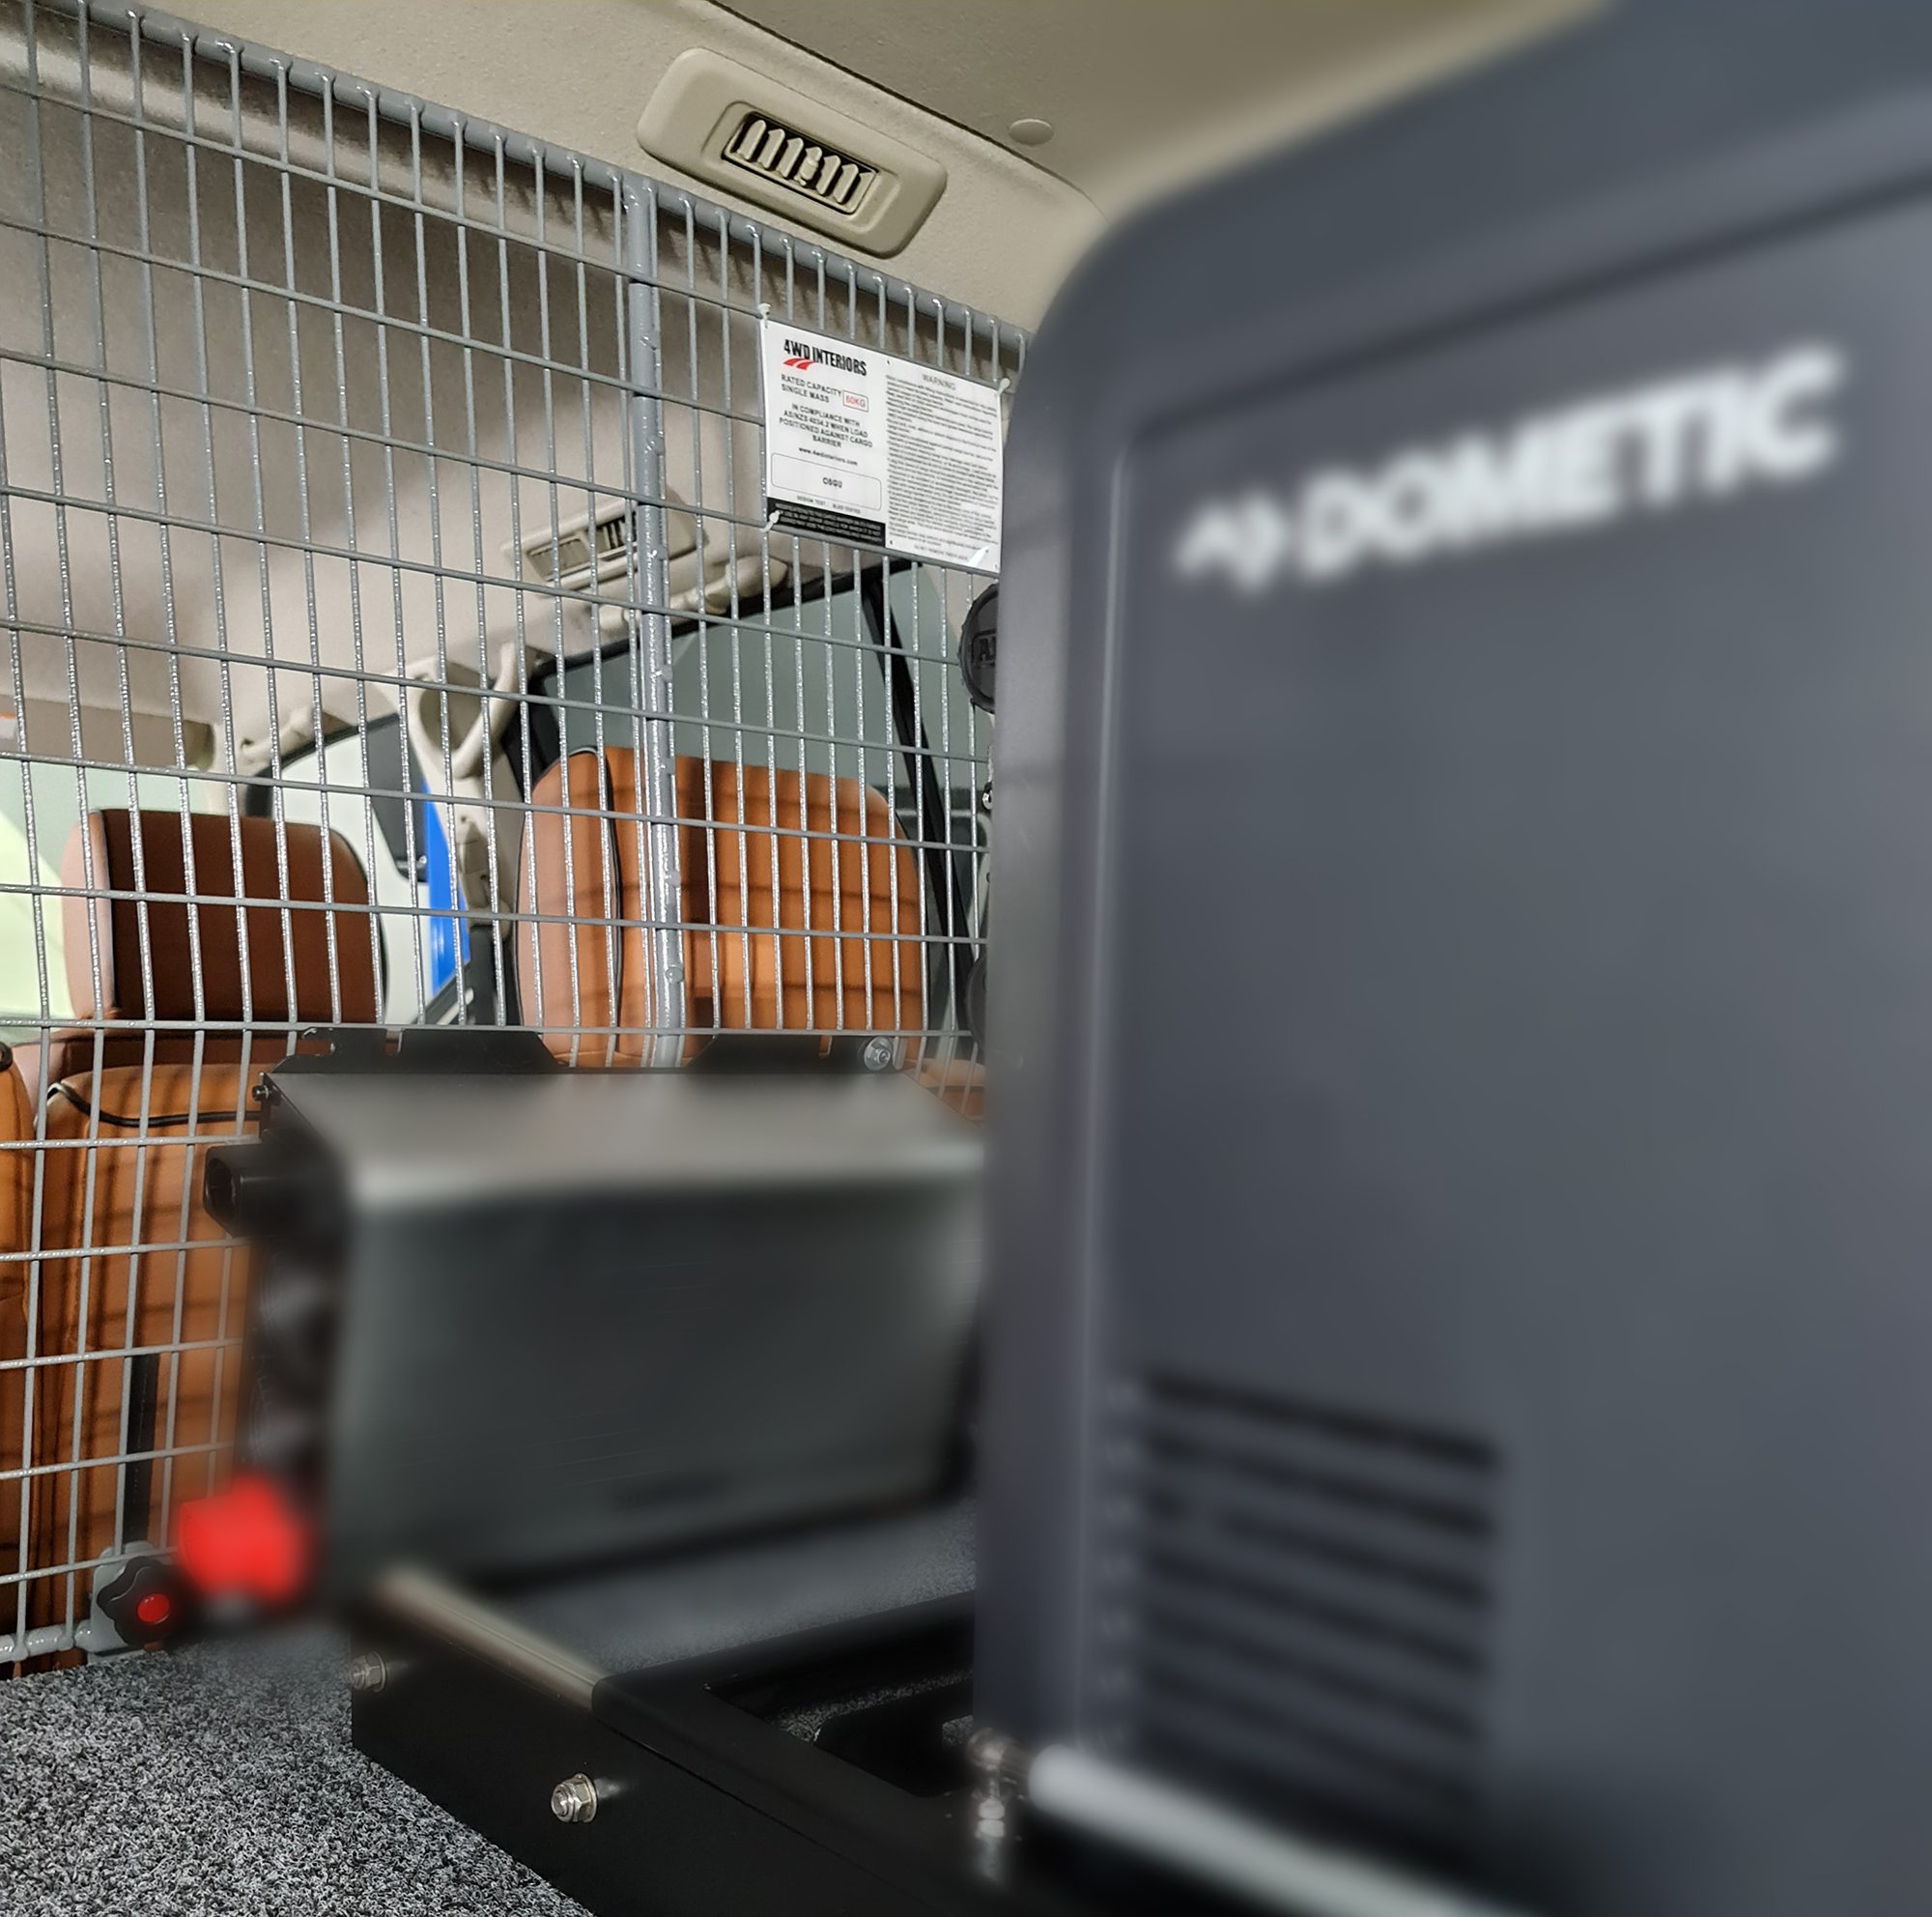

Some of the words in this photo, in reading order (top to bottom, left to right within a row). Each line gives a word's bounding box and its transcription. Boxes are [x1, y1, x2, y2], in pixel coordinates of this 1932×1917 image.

[784, 339, 810, 360] 4WD
[813, 346, 867, 376] INTERIORS
[781, 373, 805, 387] RATED
[807, 381, 842, 398] CAPACITY
[781, 383, 807, 397] SINGLE
[810, 391, 829, 403] MASS
[922, 373, 956, 391] WARNING
[799, 405, 842, 423] COMPLIANCE
[844, 417, 860, 427] WITH
[779, 417, 820, 433] POSITIONED
[821, 429, 849, 441] AGAINST
[850, 435, 873, 448] CARGO
[812, 434, 842, 448] BARRIER
[830, 422, 850, 432] WHEN
[851, 428, 868, 438] LOAD
[1296, 344, 1843, 580] DOMETIC
